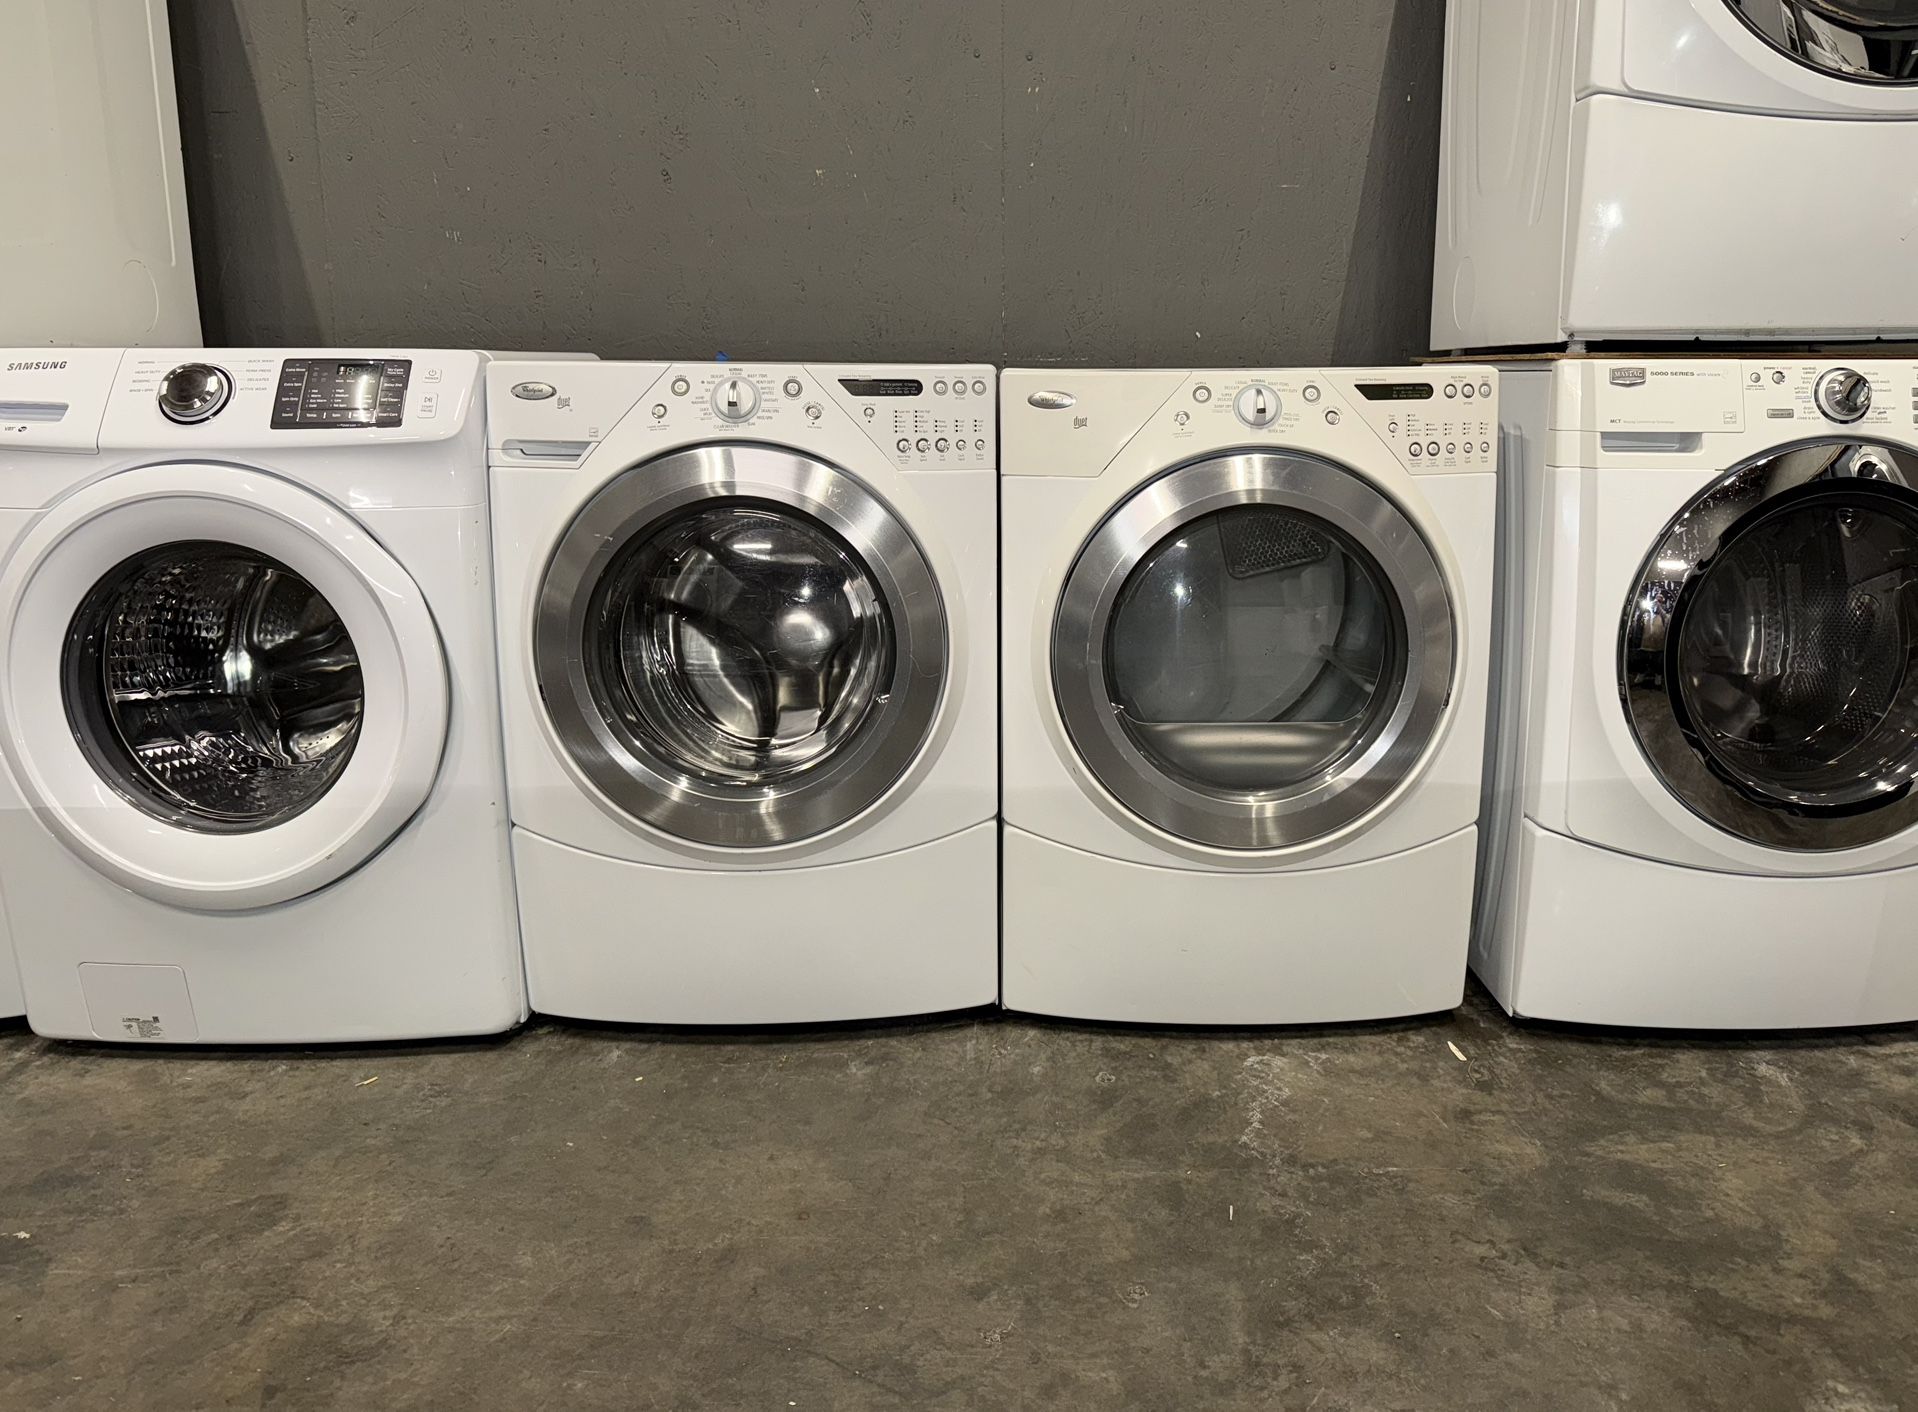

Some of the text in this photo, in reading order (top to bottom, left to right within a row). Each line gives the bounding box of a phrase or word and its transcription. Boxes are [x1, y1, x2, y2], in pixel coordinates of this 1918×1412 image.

[7, 361, 68, 372] SAMSUNG
[1613, 370, 1643, 378] MAYTAG
[1073, 416, 1088, 429] duet
